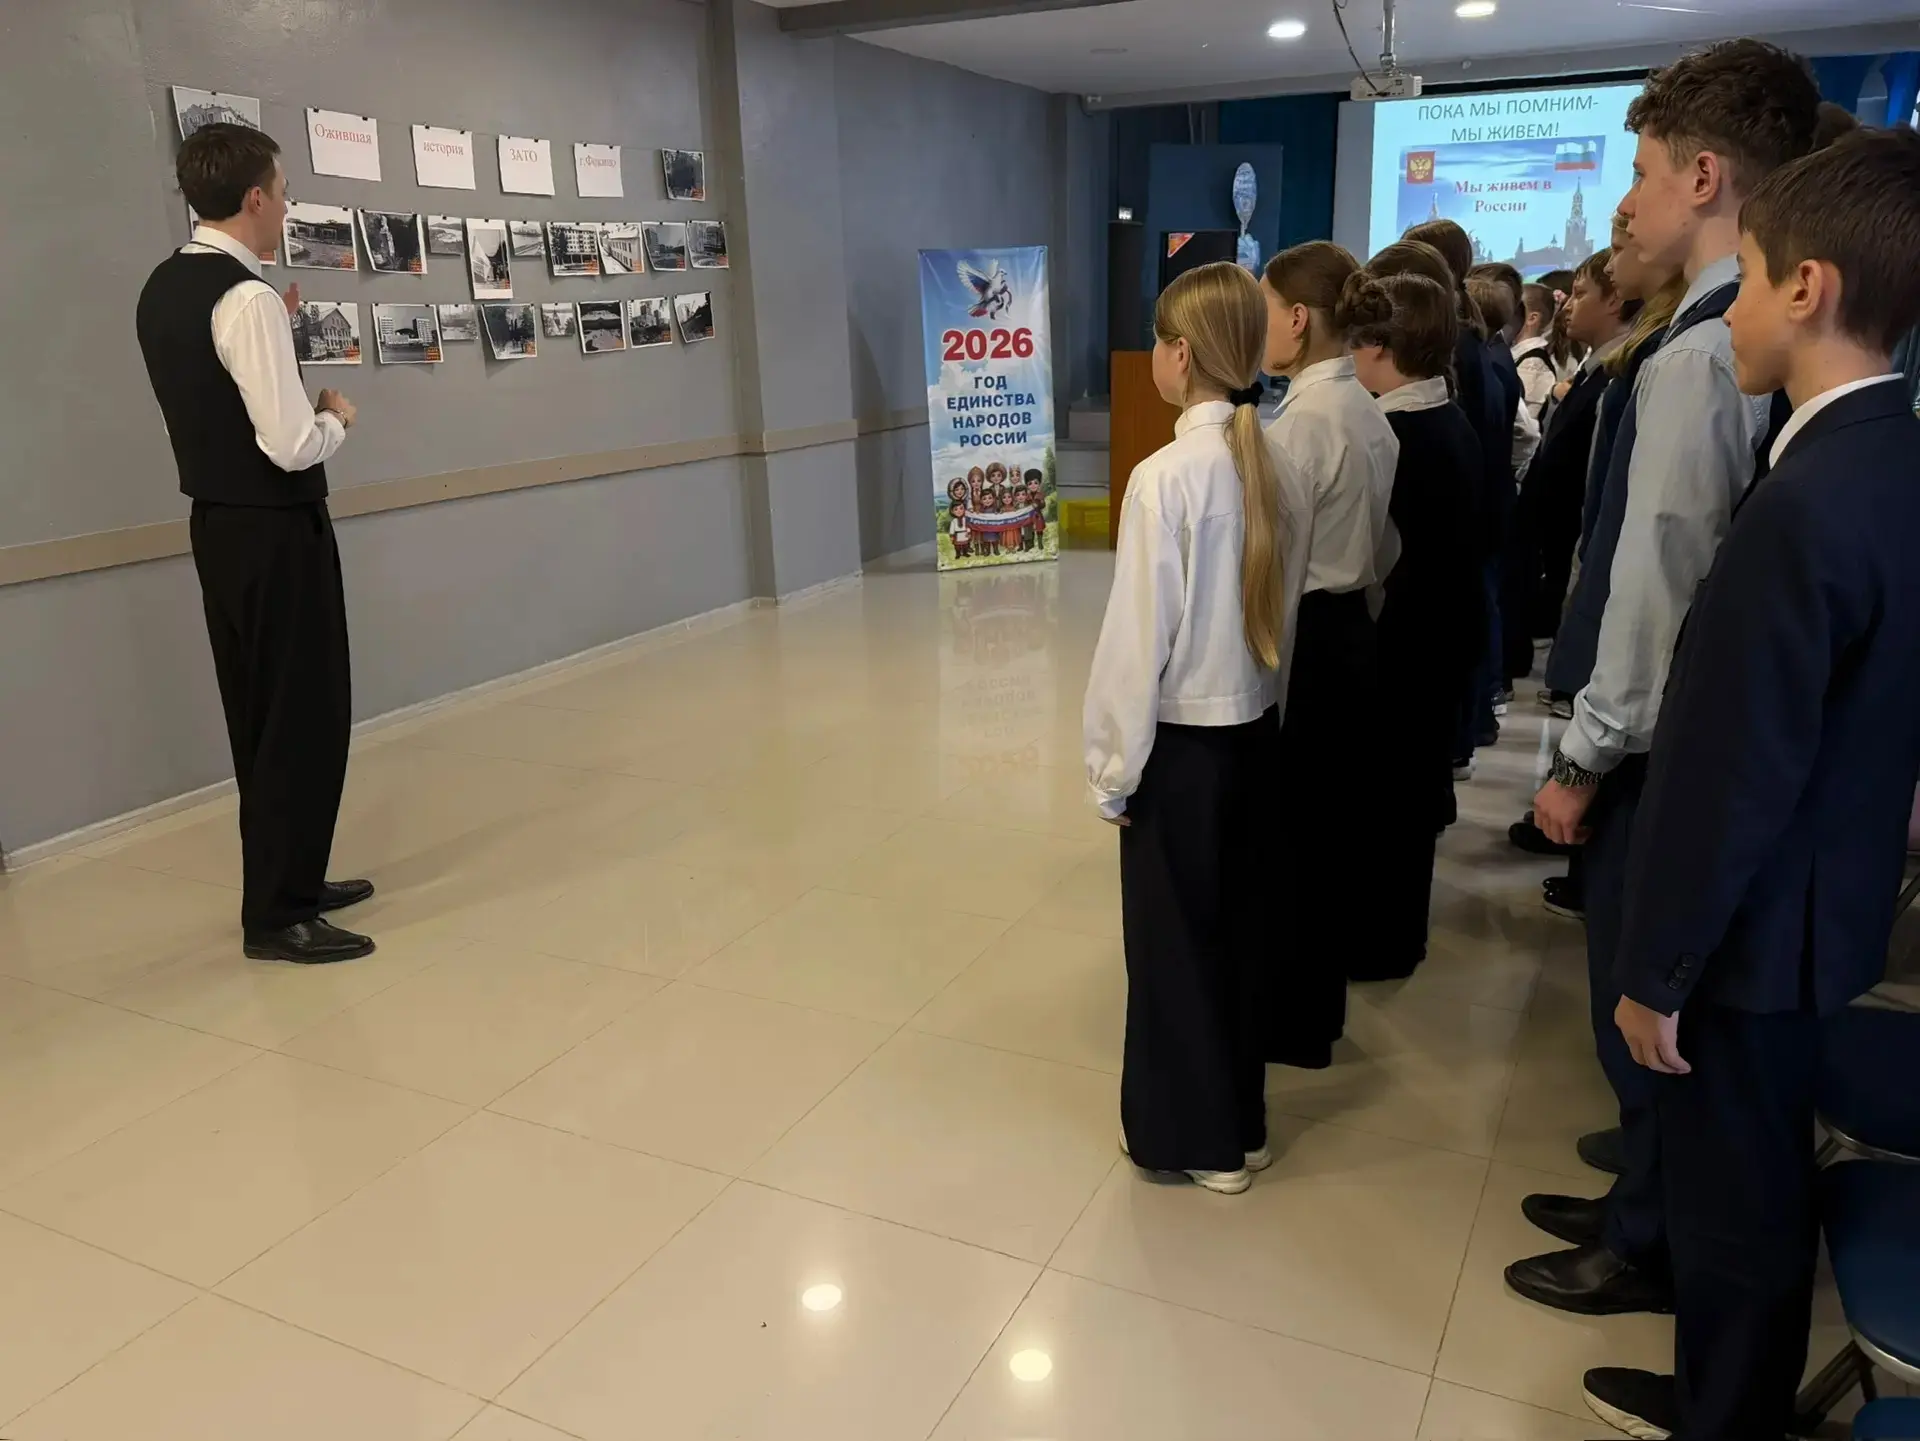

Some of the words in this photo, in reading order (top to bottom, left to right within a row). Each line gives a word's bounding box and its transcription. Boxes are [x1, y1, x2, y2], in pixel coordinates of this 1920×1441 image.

[1418, 104, 1464, 120] ПОКА
[1470, 101, 1500, 117] МЫ
[1506, 95, 1599, 115] ПОМНИМ-
[314, 123, 372, 145] Ожившая
[1451, 127, 1482, 142] МЫ
[1487, 122, 1559, 140] ЖИВЕМ!
[423, 141, 464, 157] история
[509, 148, 538, 163] ЗАТО
[1455, 181, 1483, 194] Мы
[1487, 181, 1538, 192] живем
[1543, 181, 1552, 190] в
[1475, 200, 1527, 212] России
[942, 327, 1035, 361] 2026
[974, 375, 1008, 390] ГОД
[947, 393, 1036, 411] ЕДИНСТВА
[952, 411, 1032, 429] НАРОДОВ
[960, 431, 1028, 448] РОССИИ
